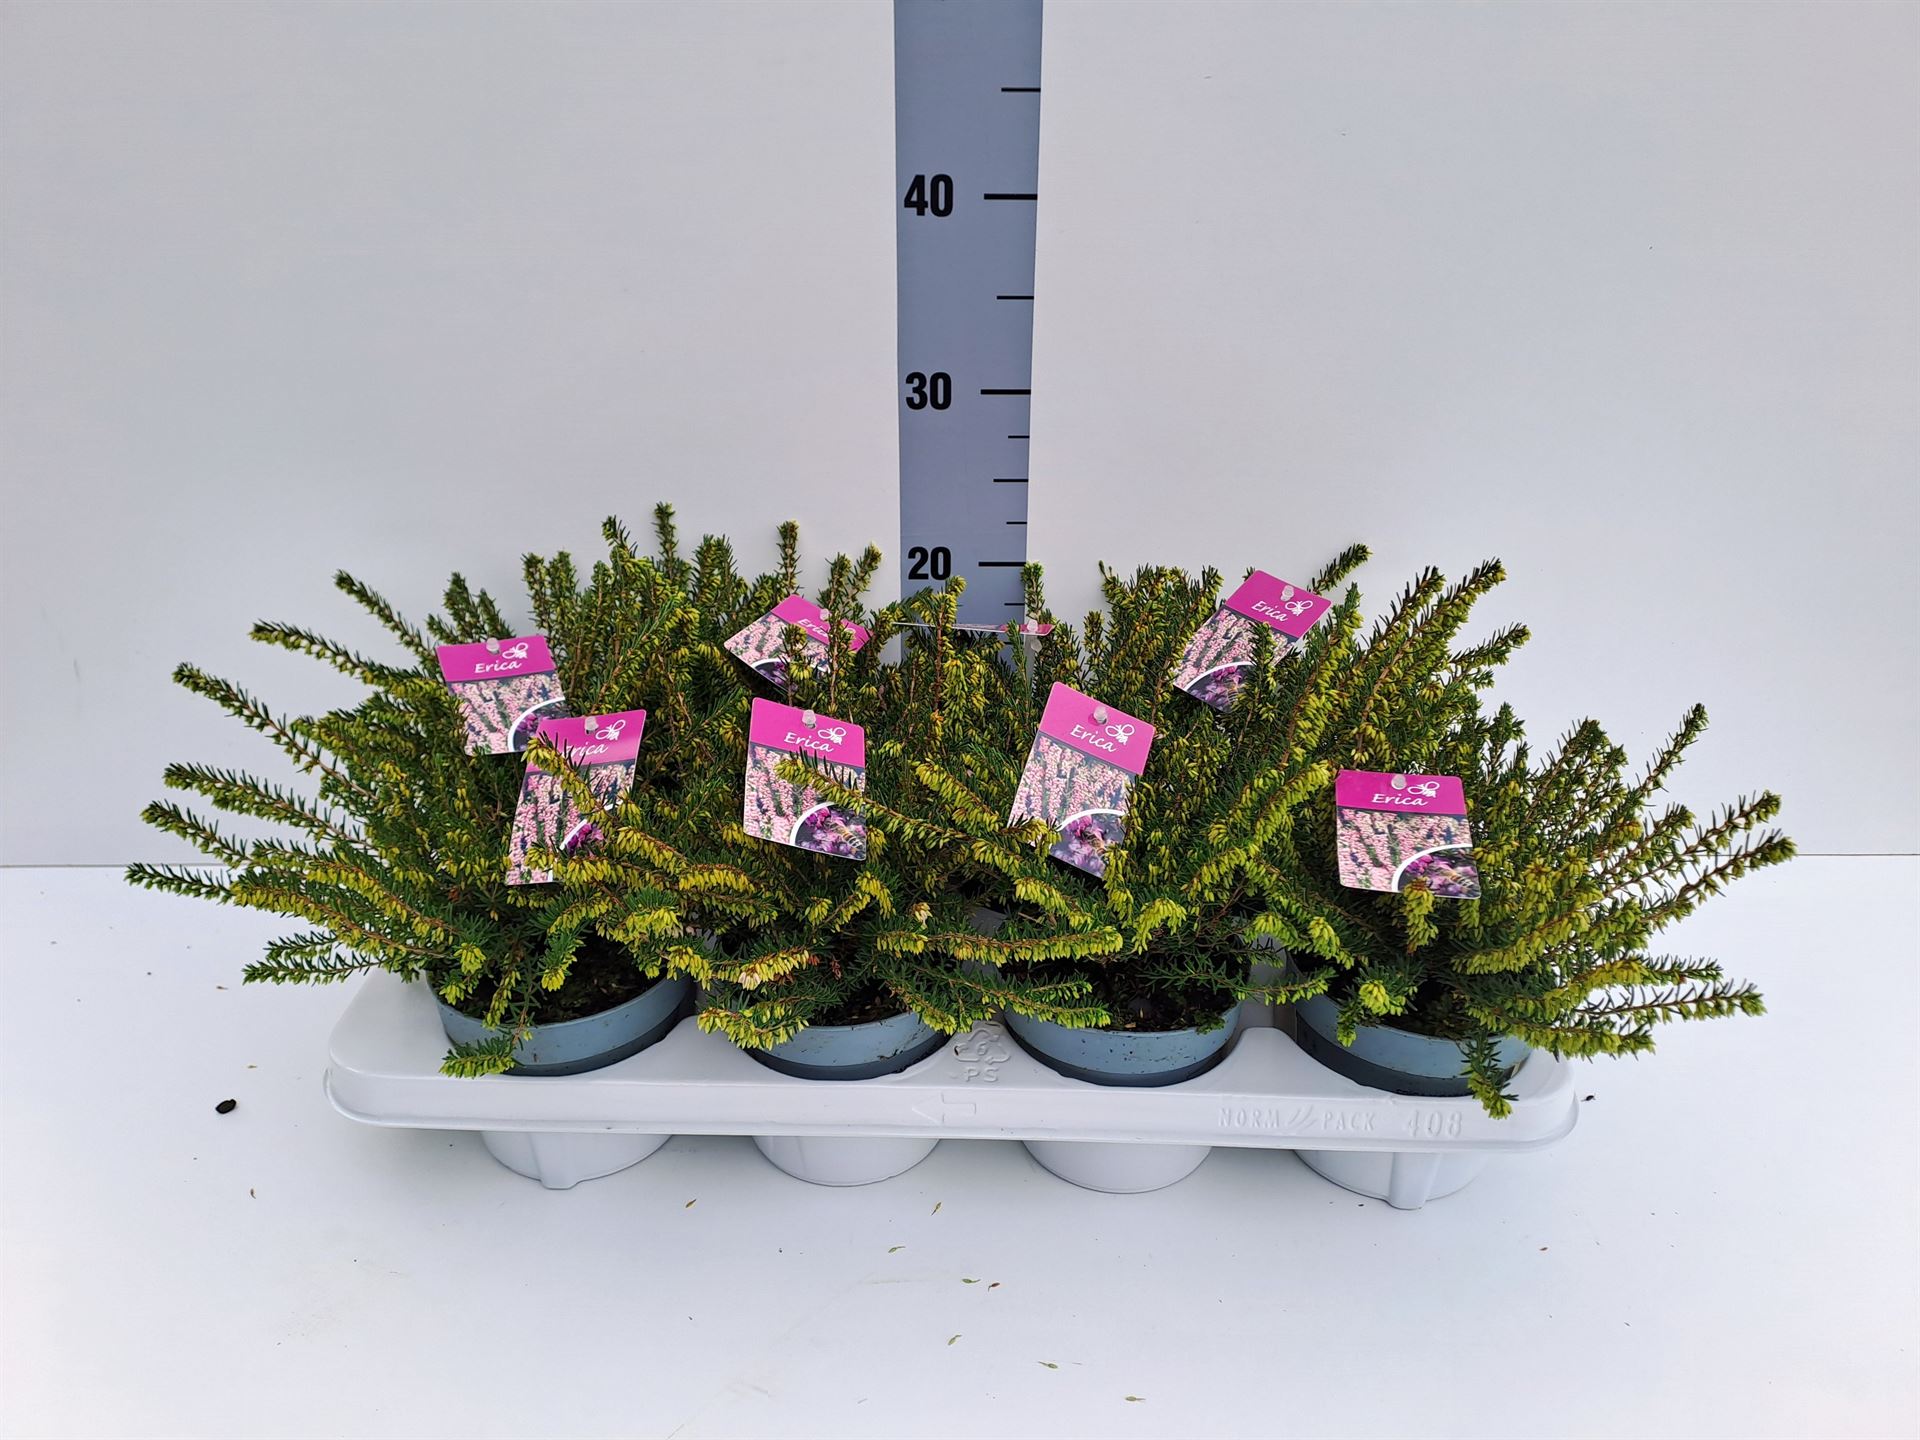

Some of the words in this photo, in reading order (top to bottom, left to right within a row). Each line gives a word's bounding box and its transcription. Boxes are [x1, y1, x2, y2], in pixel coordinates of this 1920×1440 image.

[903, 173, 954, 217] 40
[905, 371, 953, 411] 30
[907, 545, 952, 581] 20
[1251, 600, 1289, 622] Erica
[474, 660, 523, 674] Erica
[784, 732, 834, 753] Erica
[1070, 724, 1117, 753] Erica
[1371, 793, 1429, 806] Erica
[965, 1066, 1000, 1083] PS
[1218, 1107, 1281, 1129] NORM
[1321, 1110, 1376, 1132] PACK
[1407, 1109, 1463, 1139] 408
